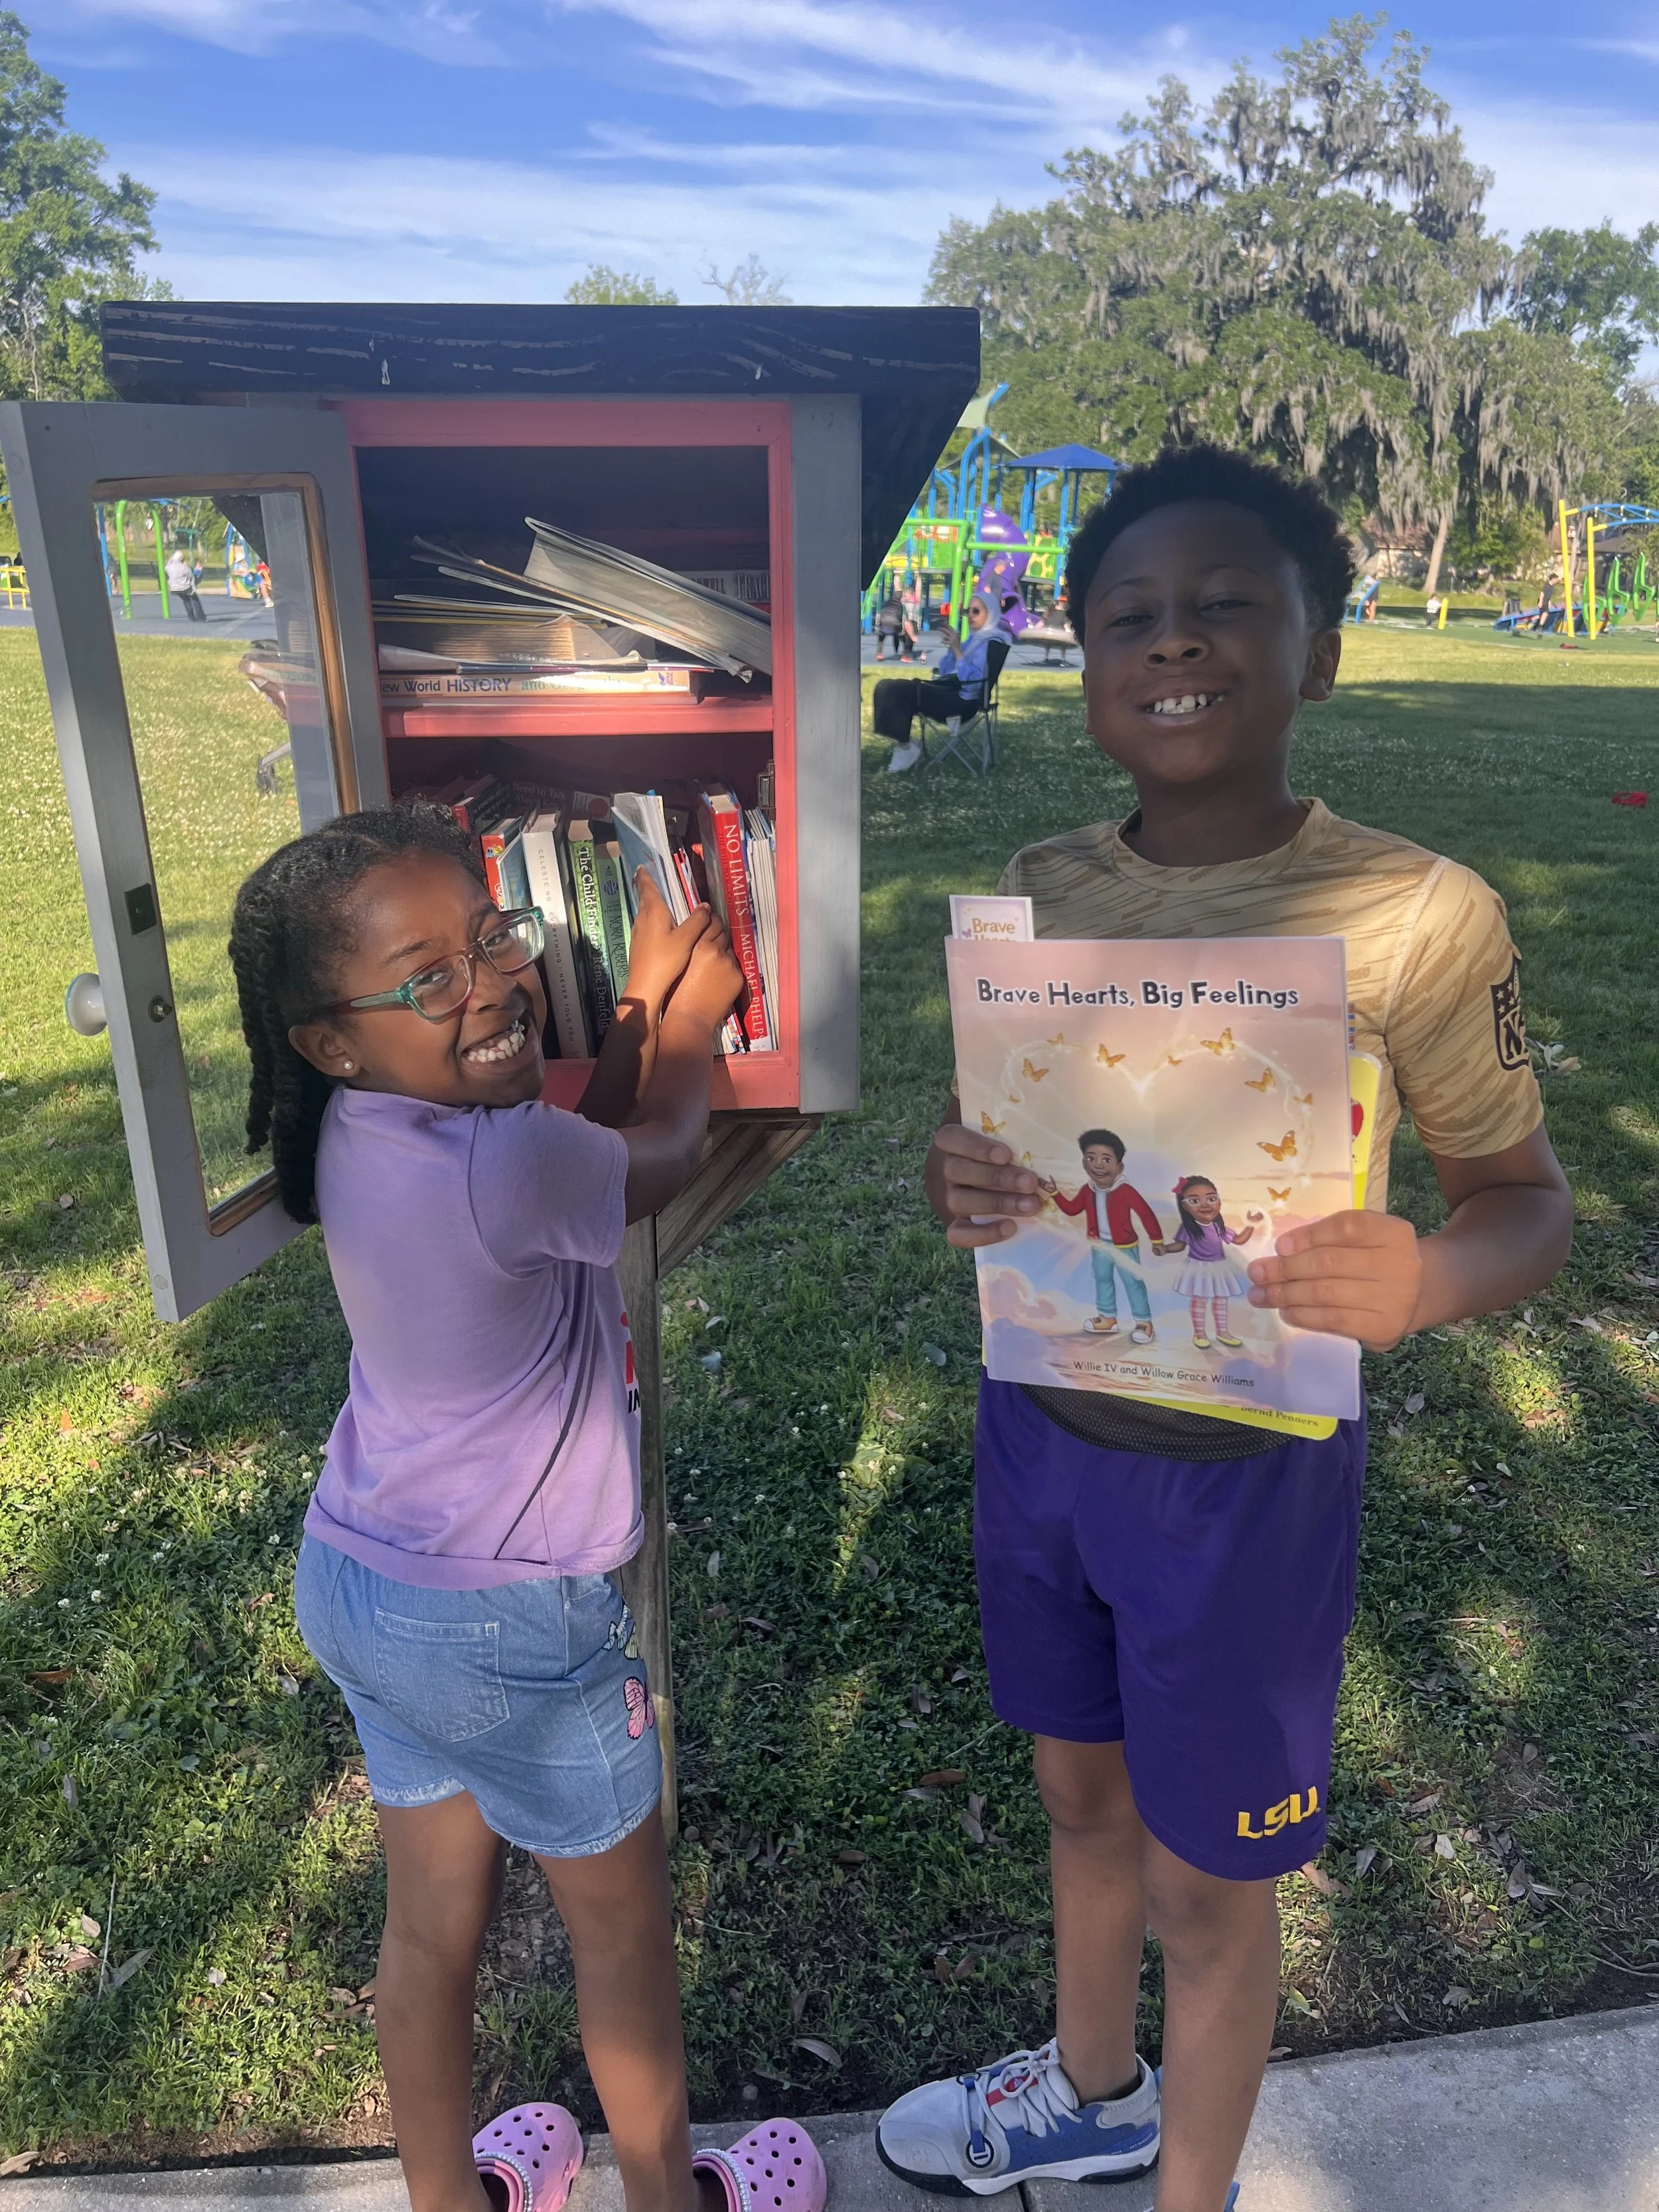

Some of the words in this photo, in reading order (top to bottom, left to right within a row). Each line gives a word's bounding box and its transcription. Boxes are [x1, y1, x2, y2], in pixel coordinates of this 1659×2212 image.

[381, 682, 398, 691] ew
[404, 680, 441, 692] World
[724, 824, 740, 853] NO
[579, 847, 591, 871] The
[582, 874, 598, 907] Child
[729, 859, 749, 916] LIMITS
[538, 849, 549, 886] CELESTE
[545, 891, 551, 901] NG
[549, 912, 562, 963] EVERYTHING
[587, 909, 601, 949] Finder
[609, 915, 624, 939] NORA
[972, 918, 1015, 934] Brave
[593, 956, 603, 983] Rene
[611, 942, 628, 978] ROBERTS
[597, 987, 612, 1029] Denfeld
[976, 979, 1041, 1005] Brave
[1047, 982, 1135, 1007] Hearts,
[1141, 981, 1183, 1008] Big
[1190, 981, 1299, 1009] Feelings
[1073, 1361, 1102, 1373] Willie
[1104, 1363, 1118, 1372] IV
[1120, 1364, 1137, 1376] and
[1140, 1366, 1175, 1378] Willow
[1177, 1369, 1207, 1382] Grace
[1210, 1374, 1254, 1387] Williams
[1275, 1411, 1319, 1426] Penners
[1237, 1786, 1317, 1839] LSU
